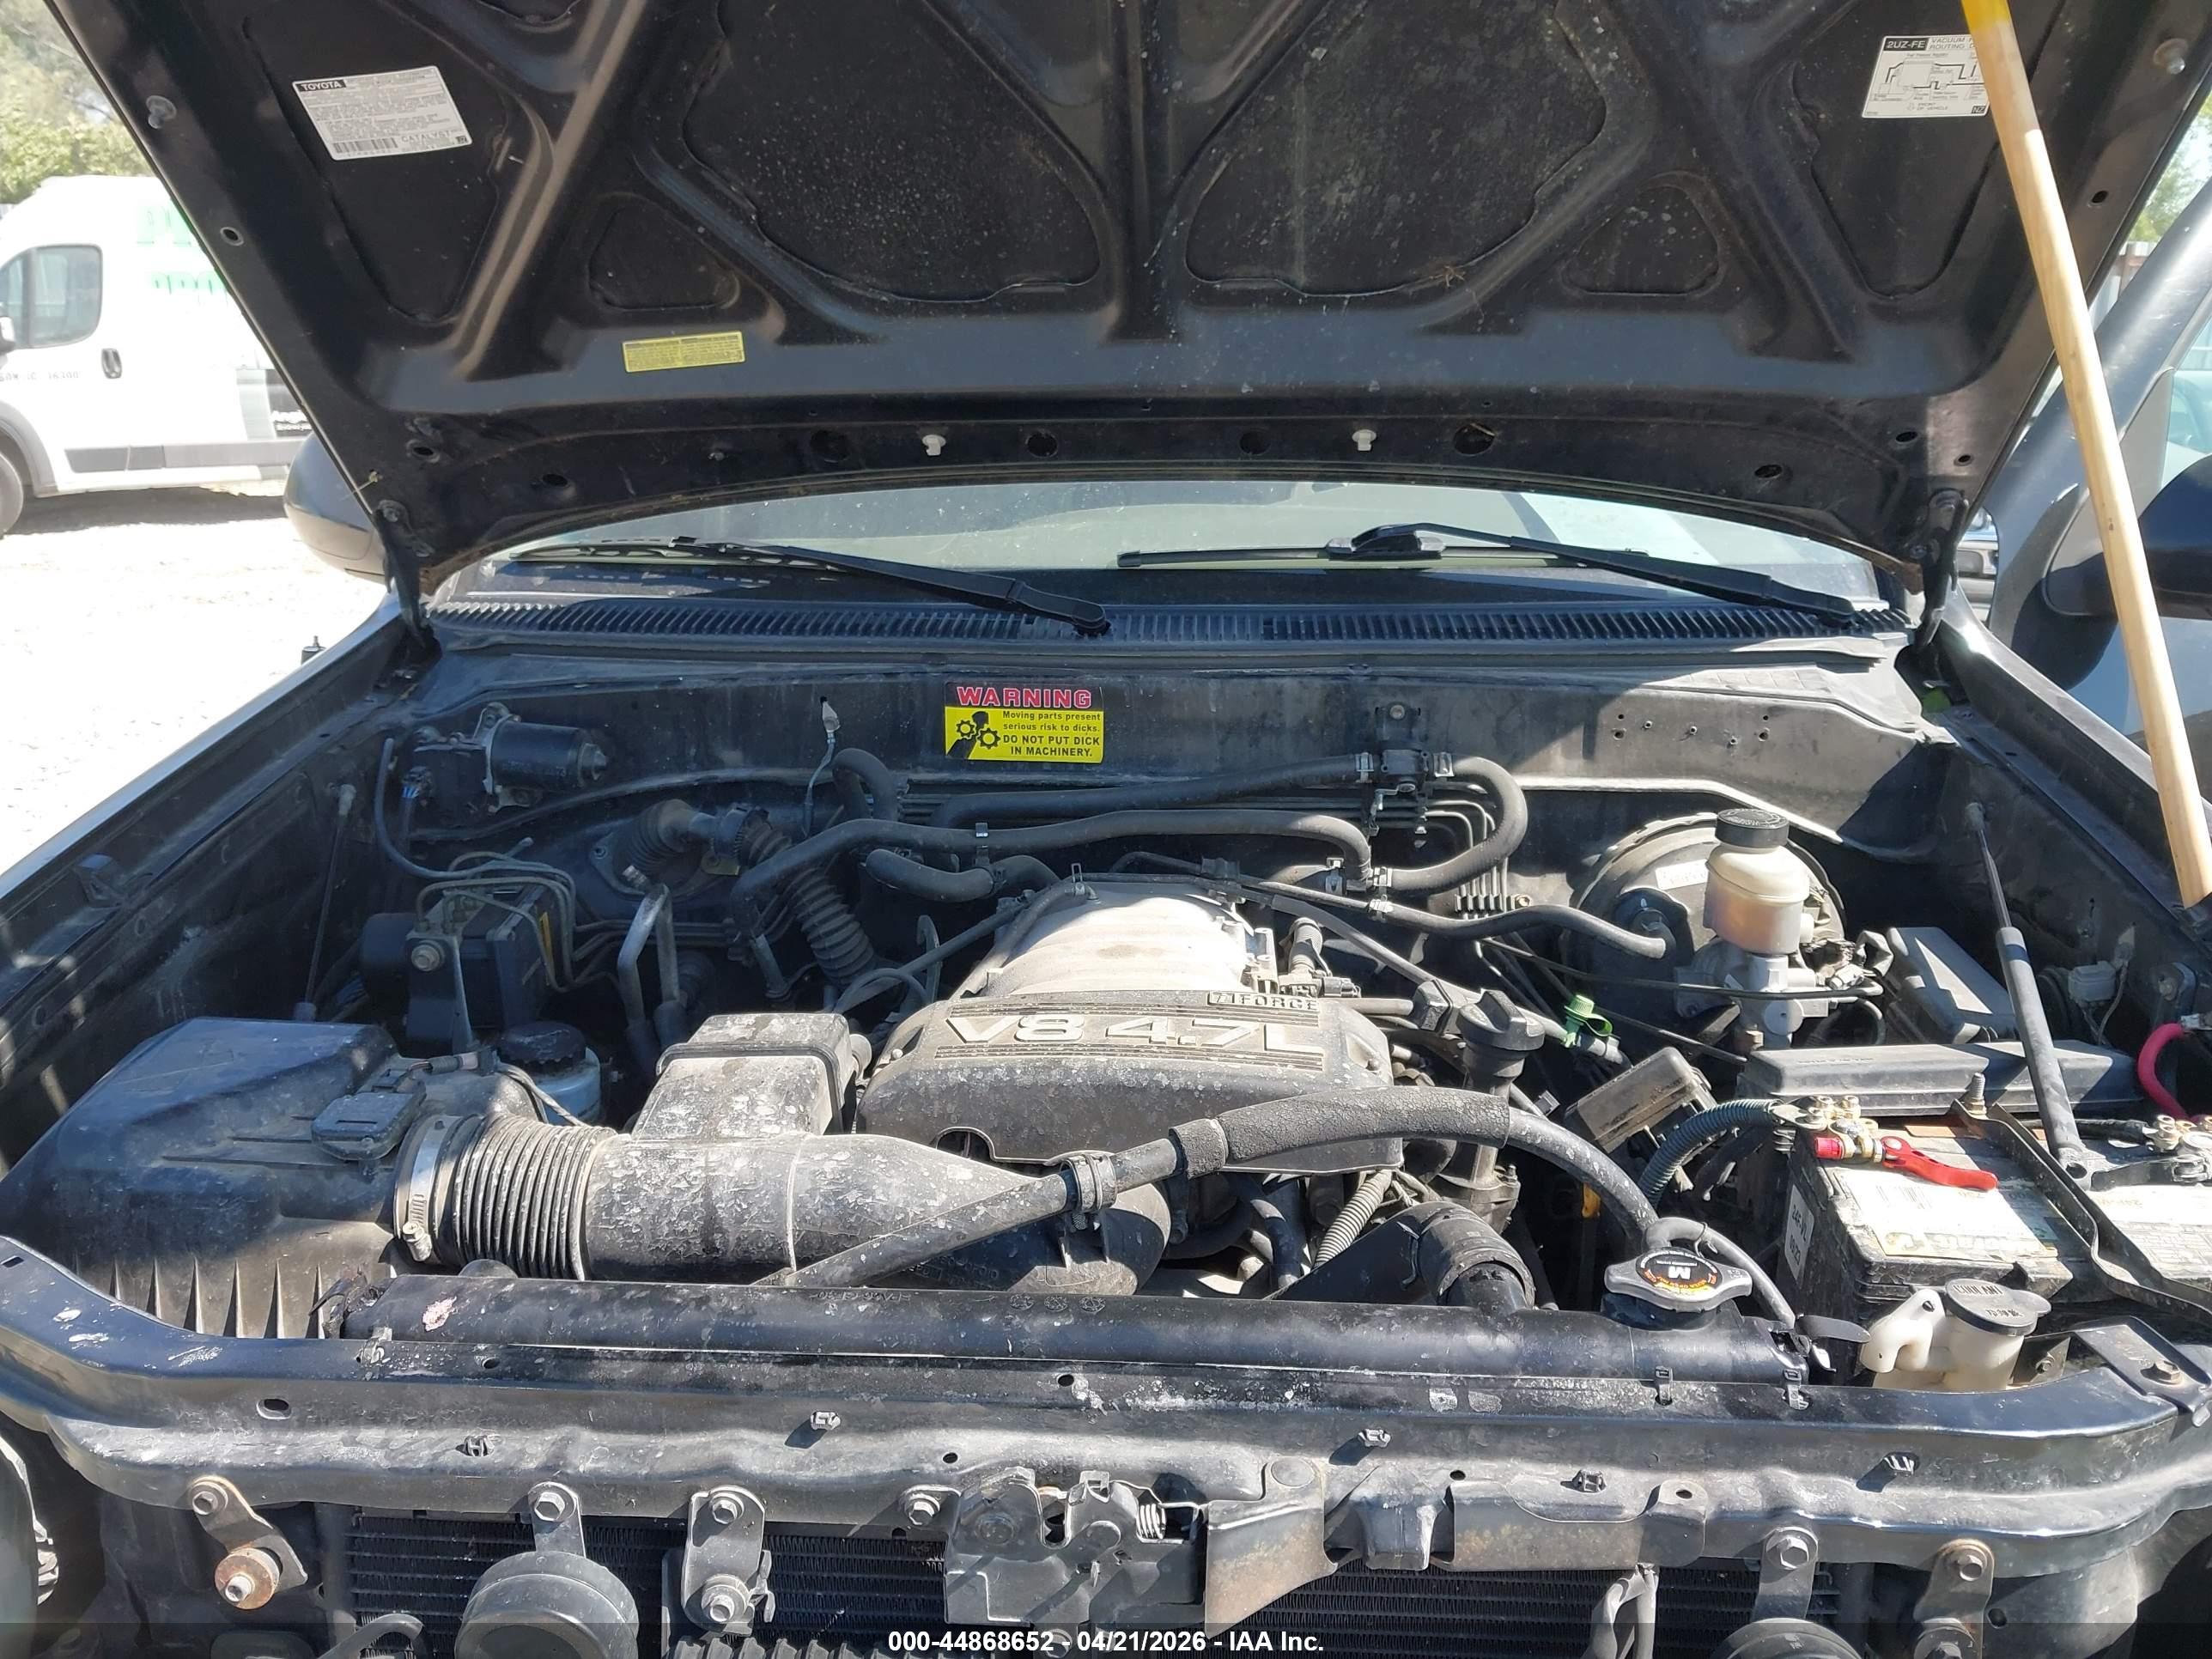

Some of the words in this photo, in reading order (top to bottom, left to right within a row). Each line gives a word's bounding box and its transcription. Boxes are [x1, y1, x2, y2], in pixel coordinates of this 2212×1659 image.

[1887, 40, 1926, 49] 2UZ-FE
[301, 81, 343, 91] TOYOTA
[401, 130, 451, 142] CATALYST
[957, 687, 1091, 708] WARNING
[1003, 711, 1035, 720] Moving
[1038, 713, 1062, 721] parts
[1066, 713, 1101, 723] present
[1073, 724, 1100, 732] dicks.
[1003, 735, 1018, 744] DO
[1023, 735, 1044, 744] NOT
[1048, 736, 1070, 744] PUT
[1073, 737, 1100, 745] DICK
[1011, 746, 1022, 755] IN
[1026, 747, 1092, 757] MACHINERY.
[1239, 994, 1319, 1011] FORCE
[945, 1016, 1084, 1043] V8
[1105, 1018, 1323, 1057] 4.7L
[1953, 1285, 2003, 1295] COOLANT
